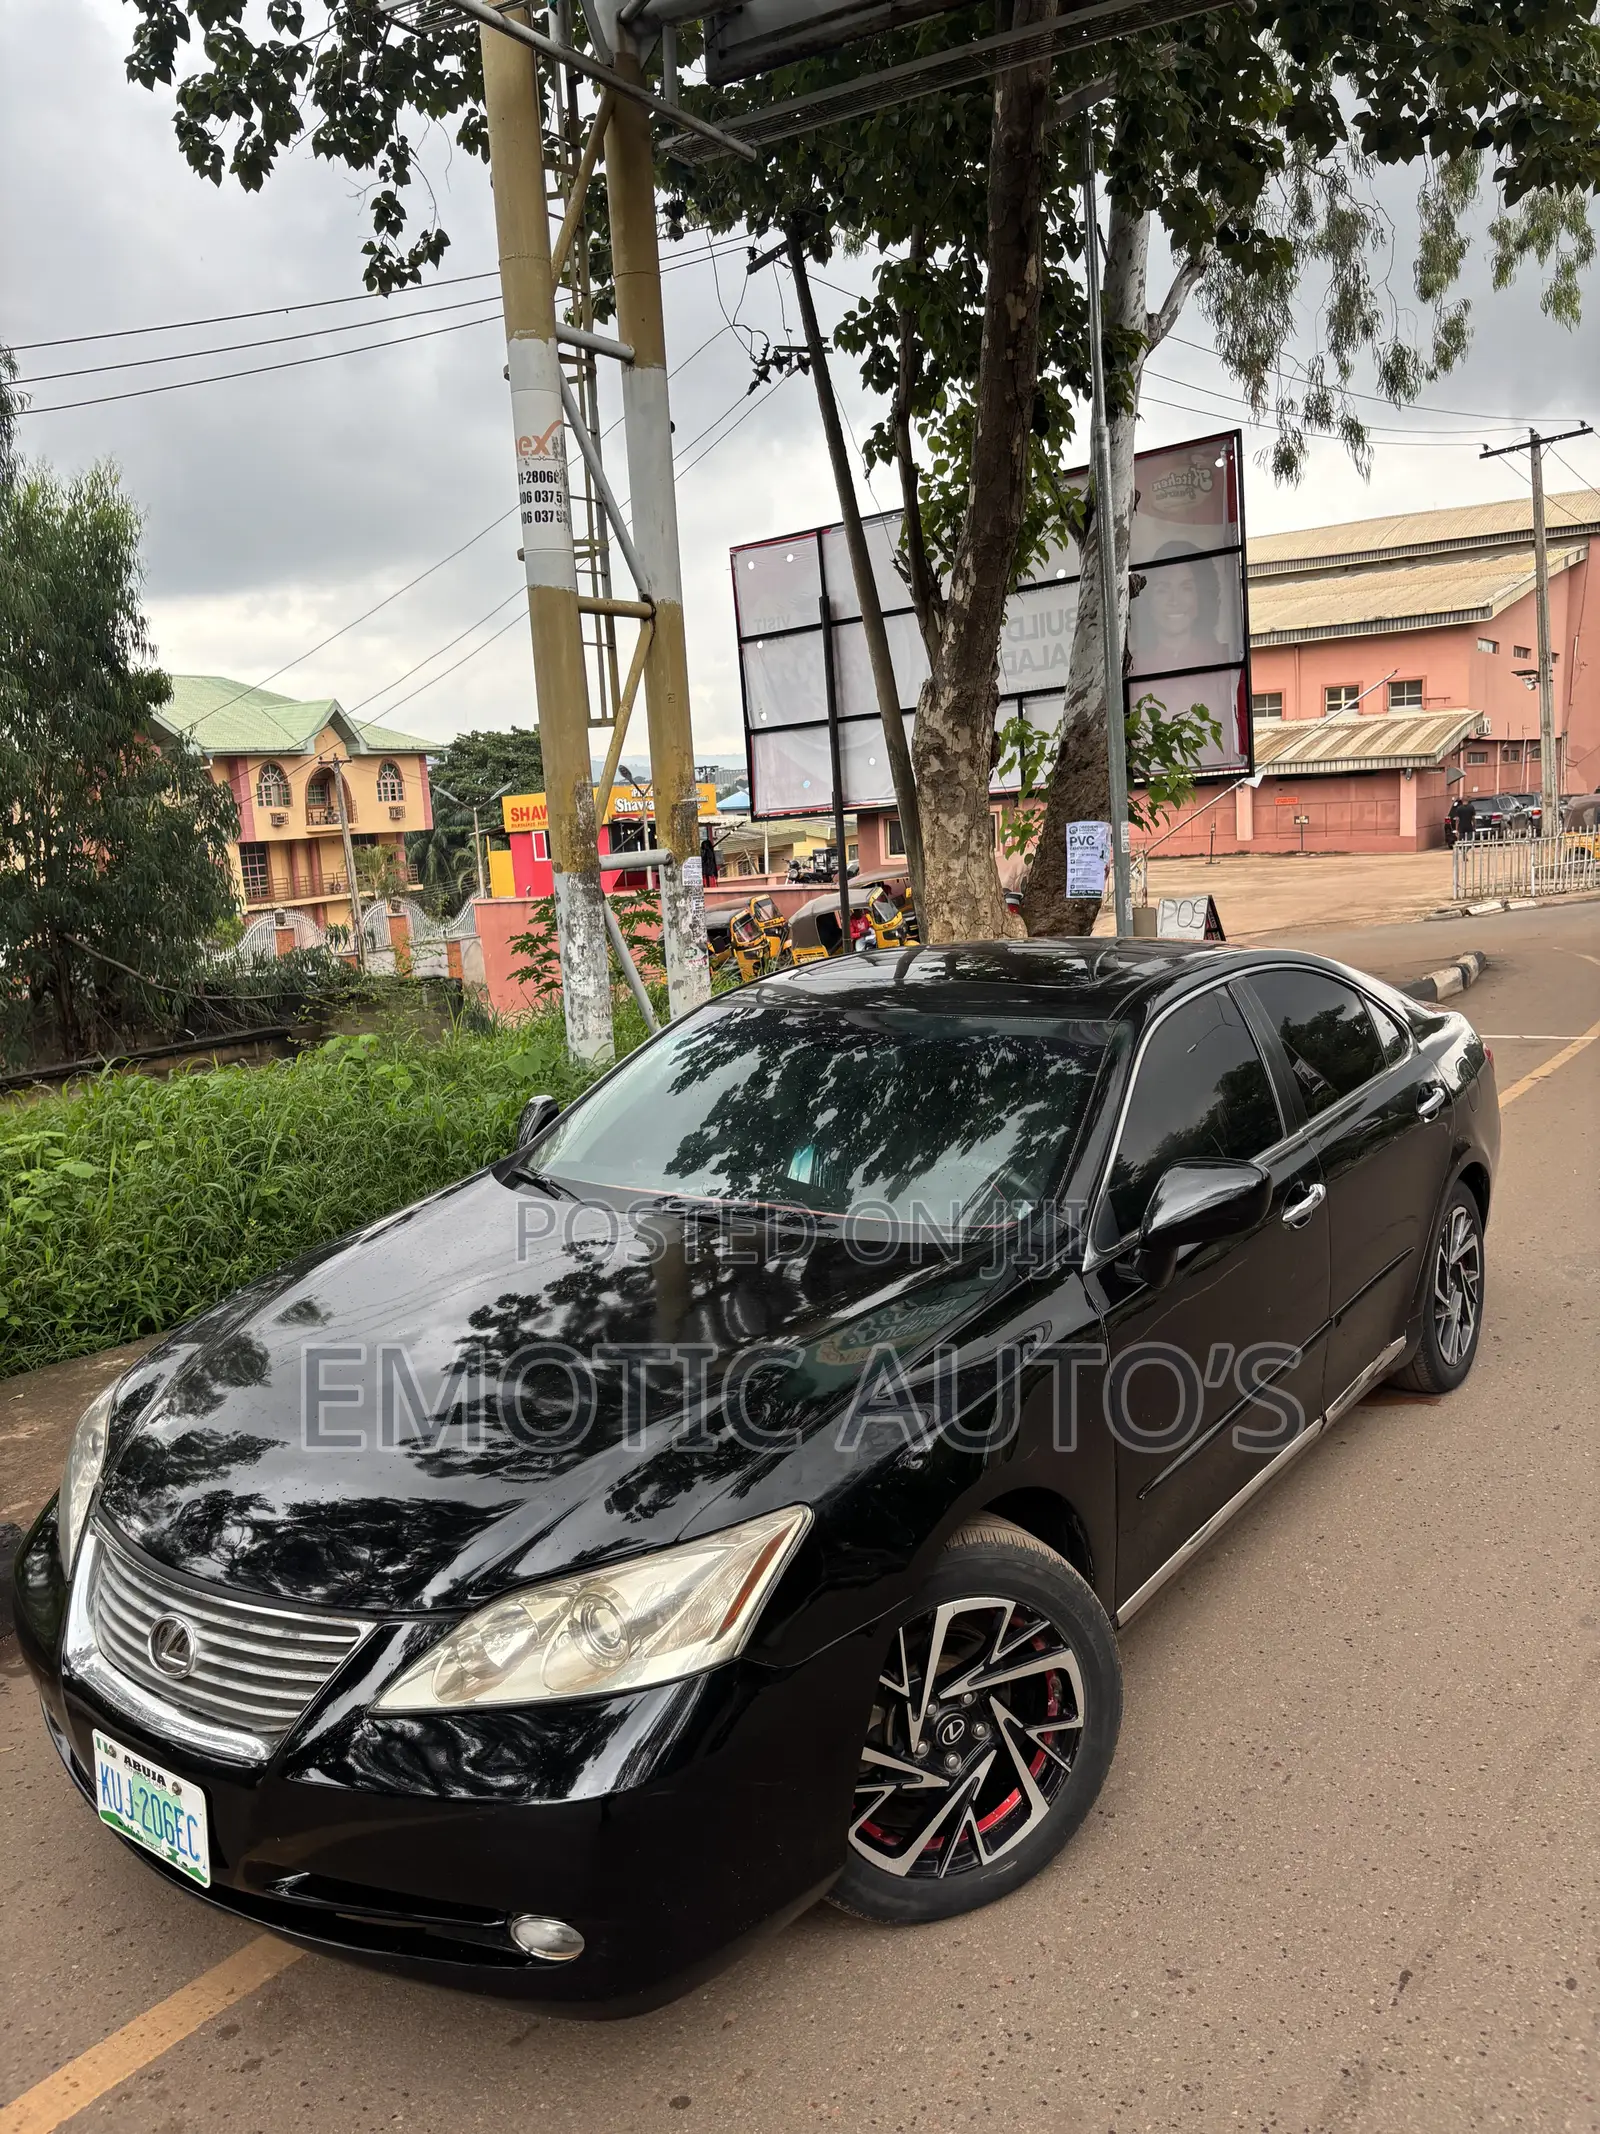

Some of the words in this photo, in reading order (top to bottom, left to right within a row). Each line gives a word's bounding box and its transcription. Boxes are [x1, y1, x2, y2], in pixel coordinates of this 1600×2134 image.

[534, 490, 554, 503] 037
[534, 510, 554, 523] 037
[1069, 835, 1095, 847] PVC
[1160, 897, 1208, 934] POS
[123, 1754, 167, 1787] ABUJA
[100, 1761, 200, 1862] KUJ-206EC
